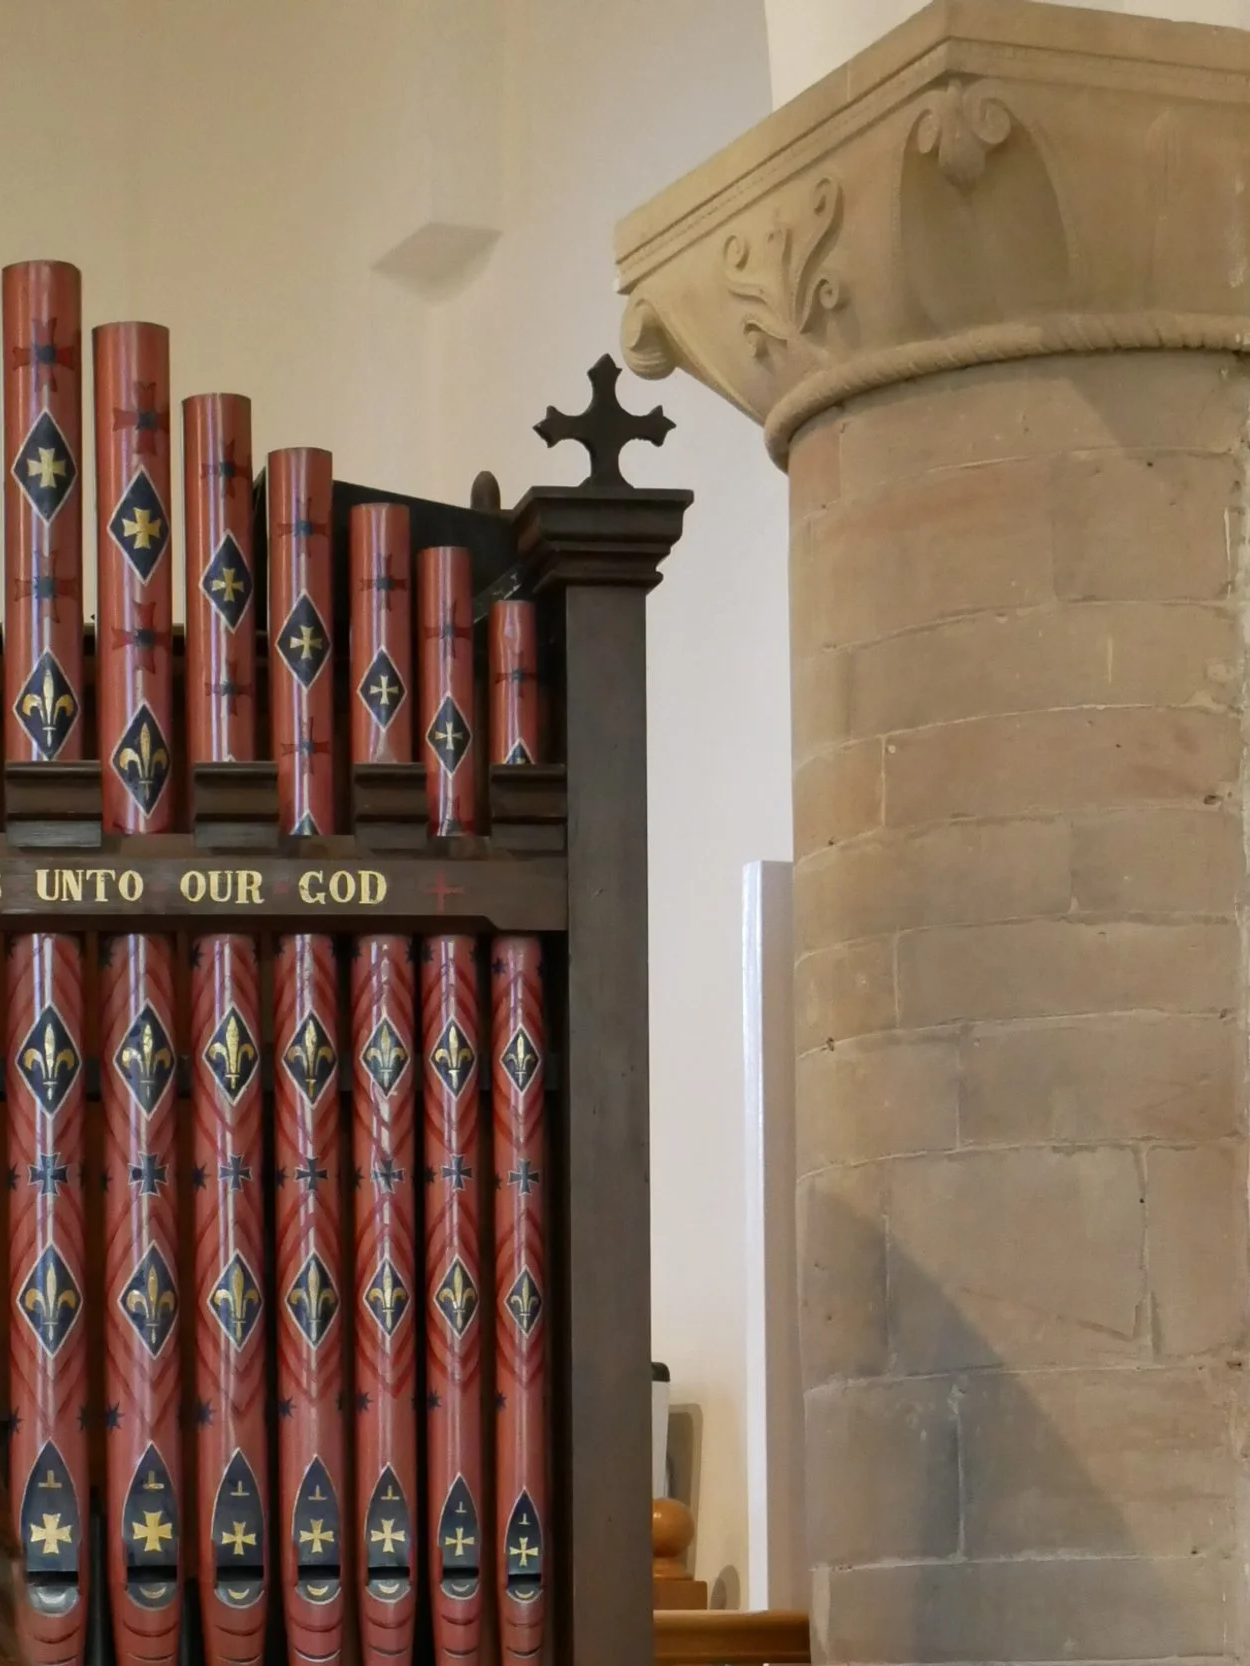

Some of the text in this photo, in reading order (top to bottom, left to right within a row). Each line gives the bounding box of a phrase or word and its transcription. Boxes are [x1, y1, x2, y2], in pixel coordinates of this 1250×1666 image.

[35, 869, 144, 902] UNTO
[180, 870, 264, 904] OUR
[298, 870, 387, 905] GOD
